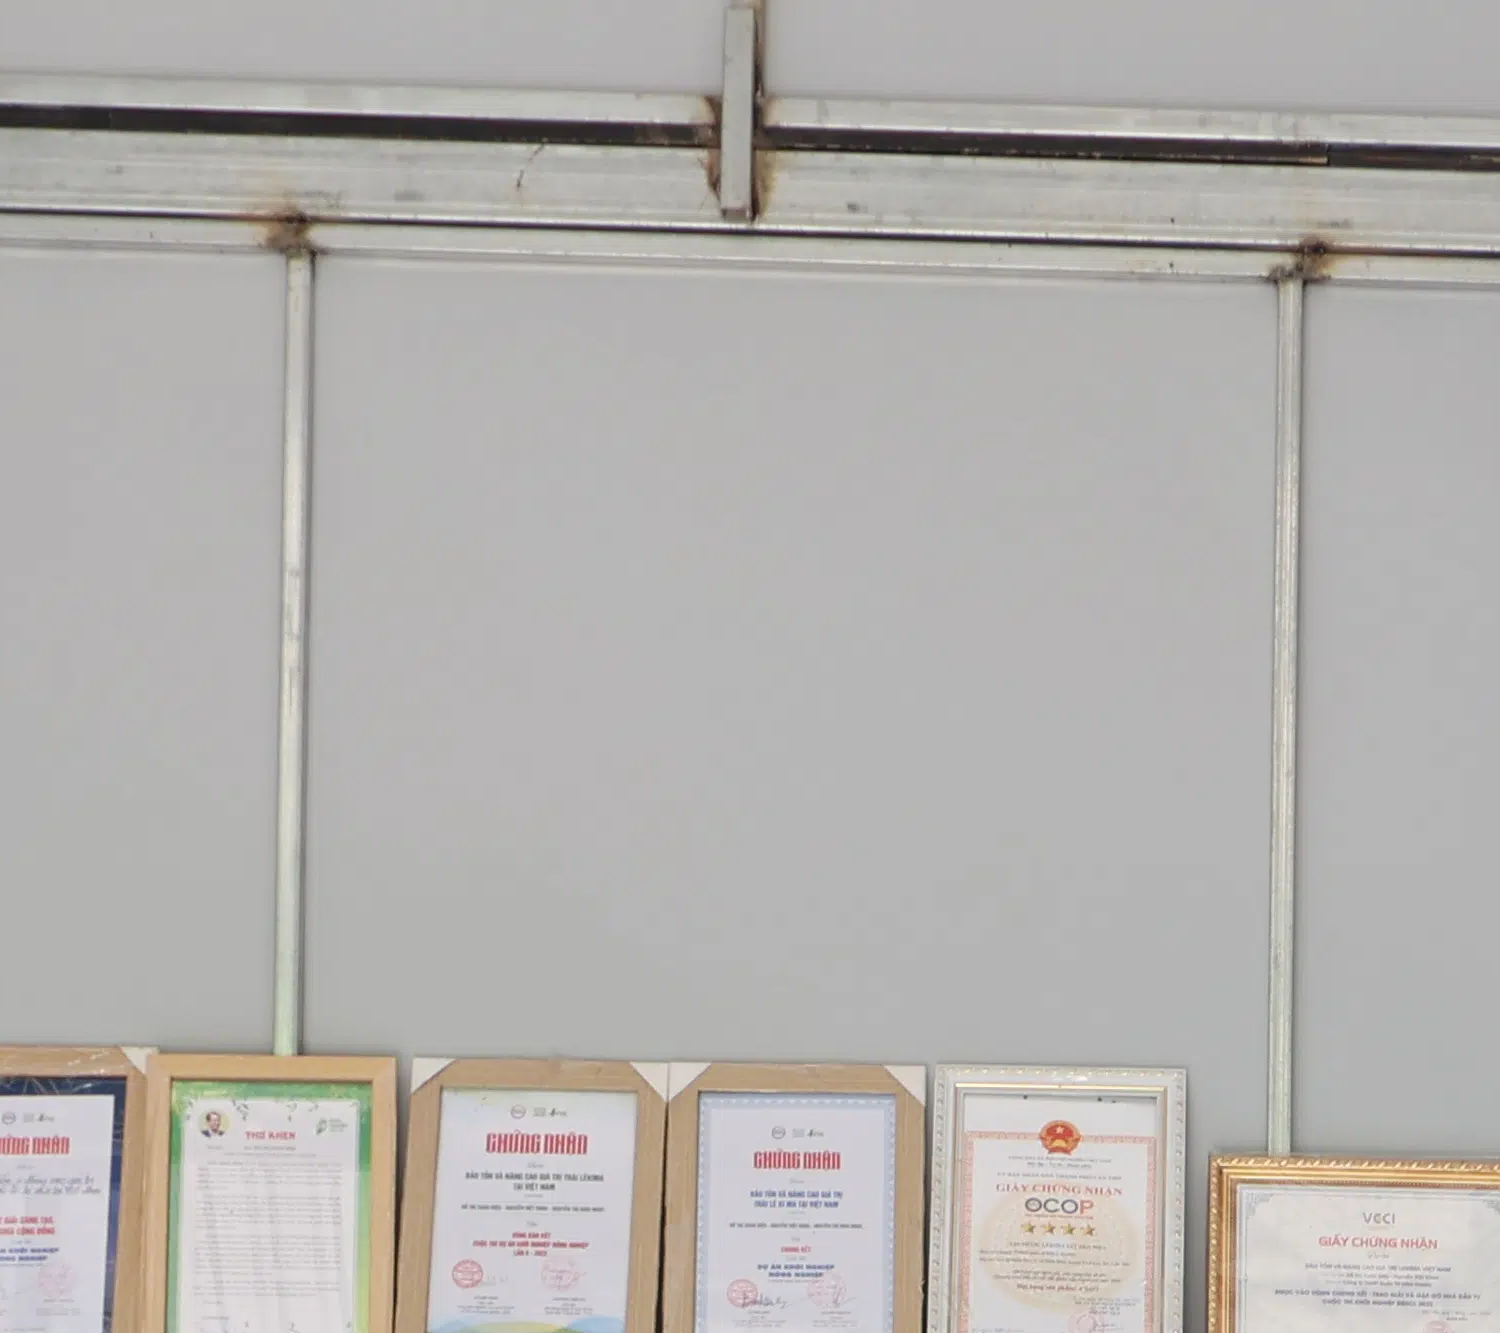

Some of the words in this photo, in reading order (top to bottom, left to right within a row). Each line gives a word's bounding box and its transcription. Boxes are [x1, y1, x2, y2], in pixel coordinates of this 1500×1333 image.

[1025, 1198, 1094, 1214] OCOP
[1363, 1212, 1396, 1225] VCCI
[1319, 1234, 1349, 1247] GIẤY
[1352, 1236, 1397, 1248] CHỨNG
[1400, 1238, 1438, 1251] NHẬN
